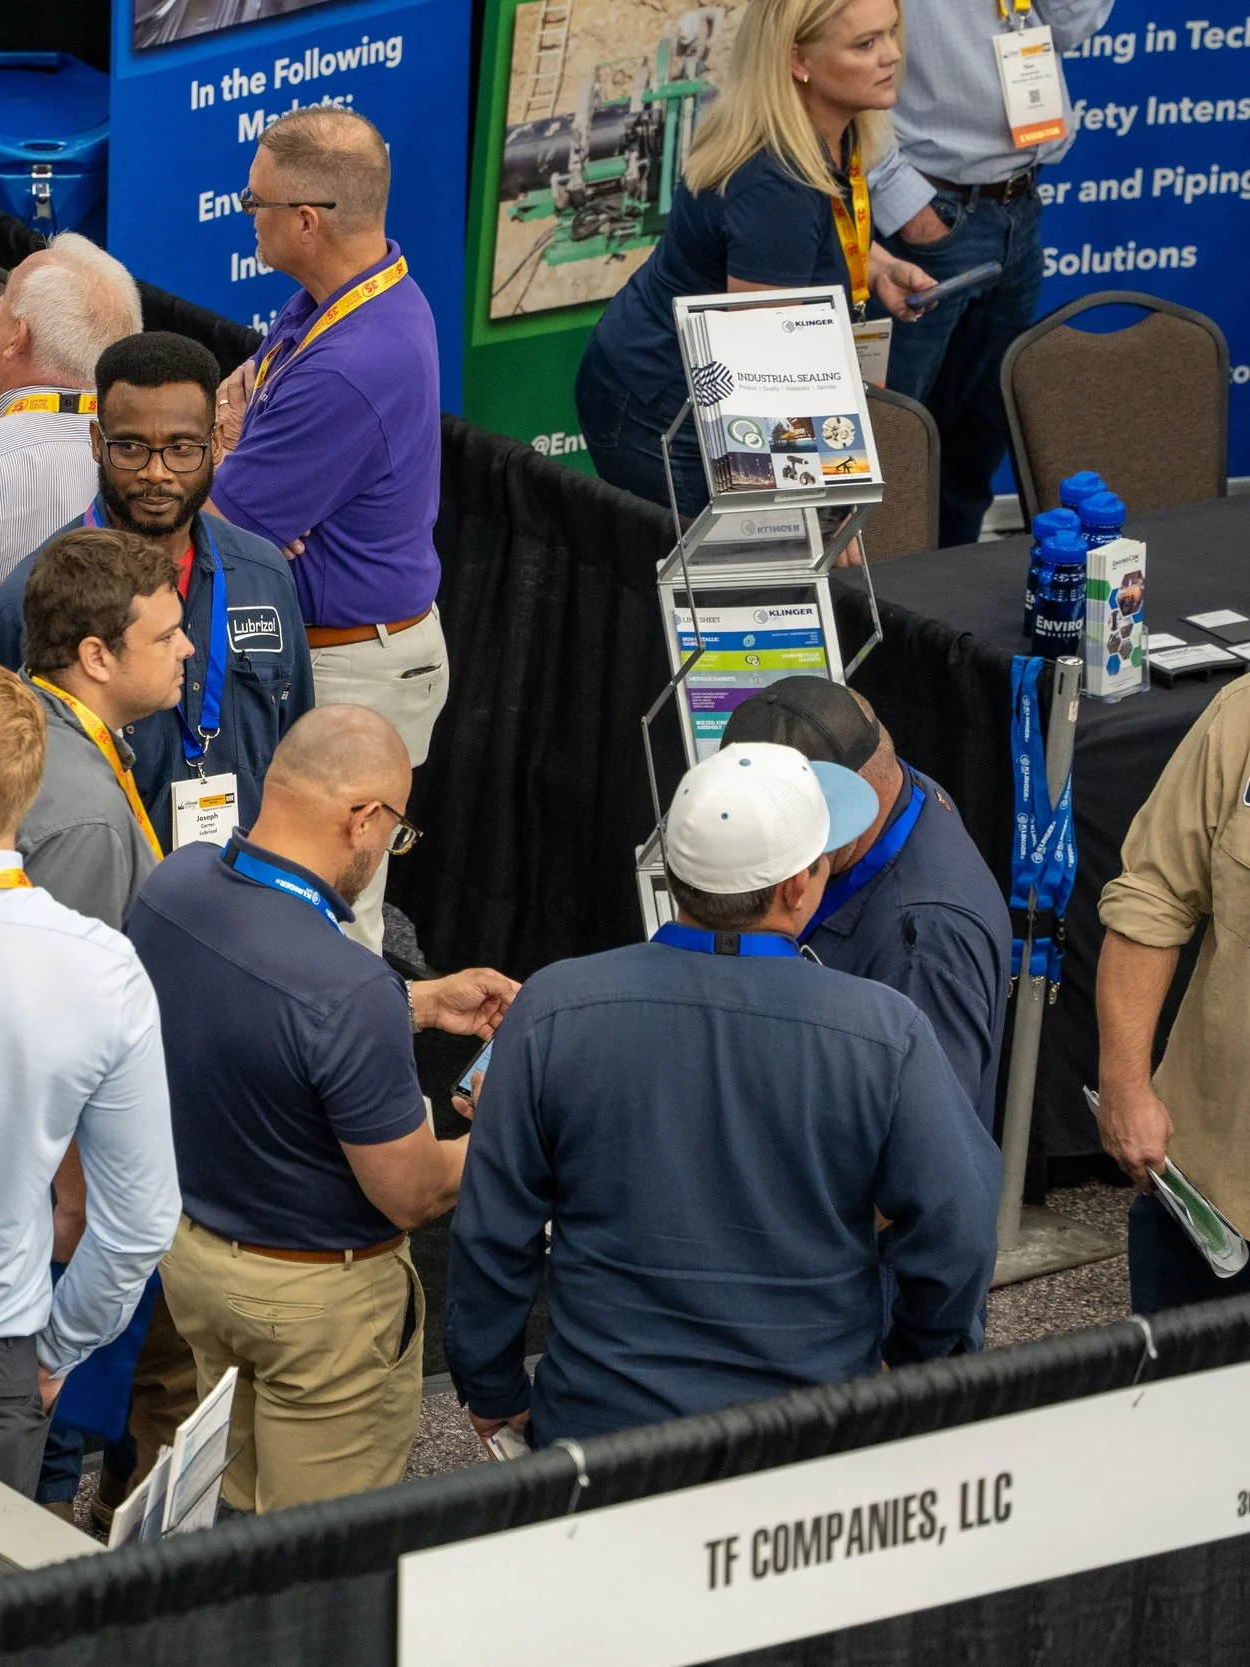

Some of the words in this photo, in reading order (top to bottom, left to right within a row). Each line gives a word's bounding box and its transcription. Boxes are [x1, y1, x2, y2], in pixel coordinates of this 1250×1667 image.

[1145, 22, 1177, 53] in
[190, 80, 215, 110] In
[221, 67, 267, 101] the
[273, 35, 403, 90] Following
[1078, 167, 1144, 203] and
[1042, 240, 1199, 278] Solutions
[794, 318, 834, 328] KLINGER
[737, 372, 796, 383] INDUSTRIAL
[796, 372, 842, 383] SEALING
[762, 384, 780, 393] Quality
[699, 616, 721, 624] SHEET
[769, 608, 813, 617] KLINGER
[234, 614, 276, 634] Lubrizol
[1036, 615, 1083, 632] ENVIRO
[1023, 766, 1031, 798] KLINGER
[196, 812, 219, 822] Joseph
[199, 828, 218, 836] Lubrizol
[1020, 824, 1028, 856] KLINGER
[1237, 1490, 1250, 1518] 3
[704, 1535, 741, 1591] TF
[750, 1488, 947, 1580] COMPANIES,
[959, 1471, 1014, 1532] LLC
